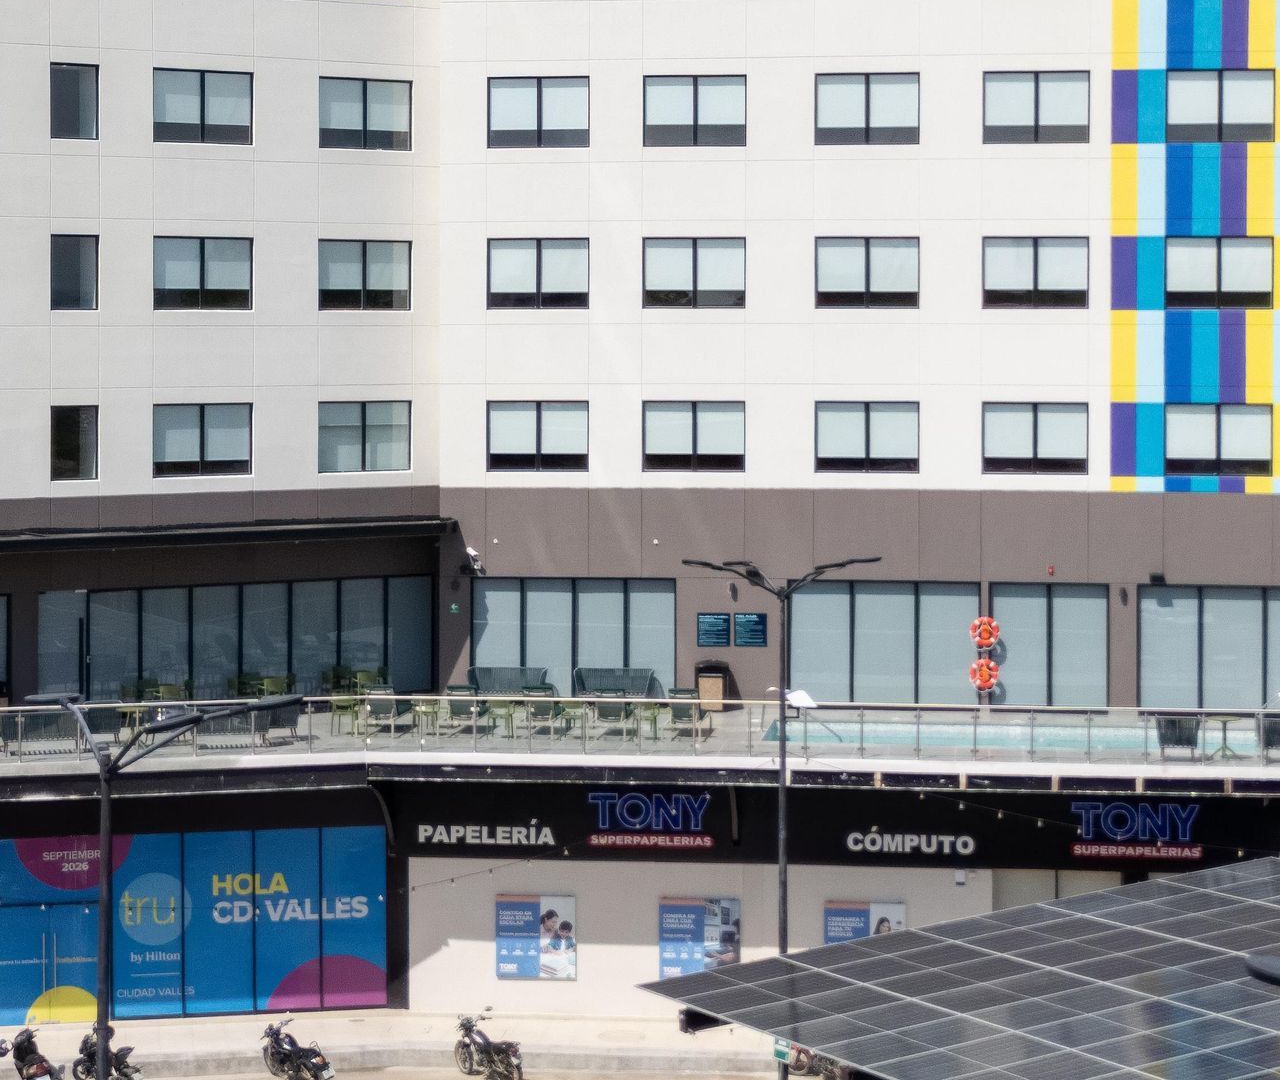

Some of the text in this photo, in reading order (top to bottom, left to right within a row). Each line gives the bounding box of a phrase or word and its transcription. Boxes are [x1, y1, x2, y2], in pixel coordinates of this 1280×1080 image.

[588, 792, 711, 829] TONY
[1072, 802, 1200, 840] TONY
[418, 818, 555, 845] PAPELERÍA
[591, 834, 711, 847] SUPERPAPELERIAS
[846, 826, 974, 855] CÓMPUTO
[42, 849, 102, 861] SEPTIEMBR
[1074, 844, 1201, 858] SUPERPAPELERIAS
[61, 862, 89, 872] 2026
[212, 872, 289, 896] HOLA
[120, 889, 176, 926] tru
[265, 895, 370, 922] VALLES
[129, 951, 181, 965] by Hilton
[116, 987, 156, 998] CIUDAD
